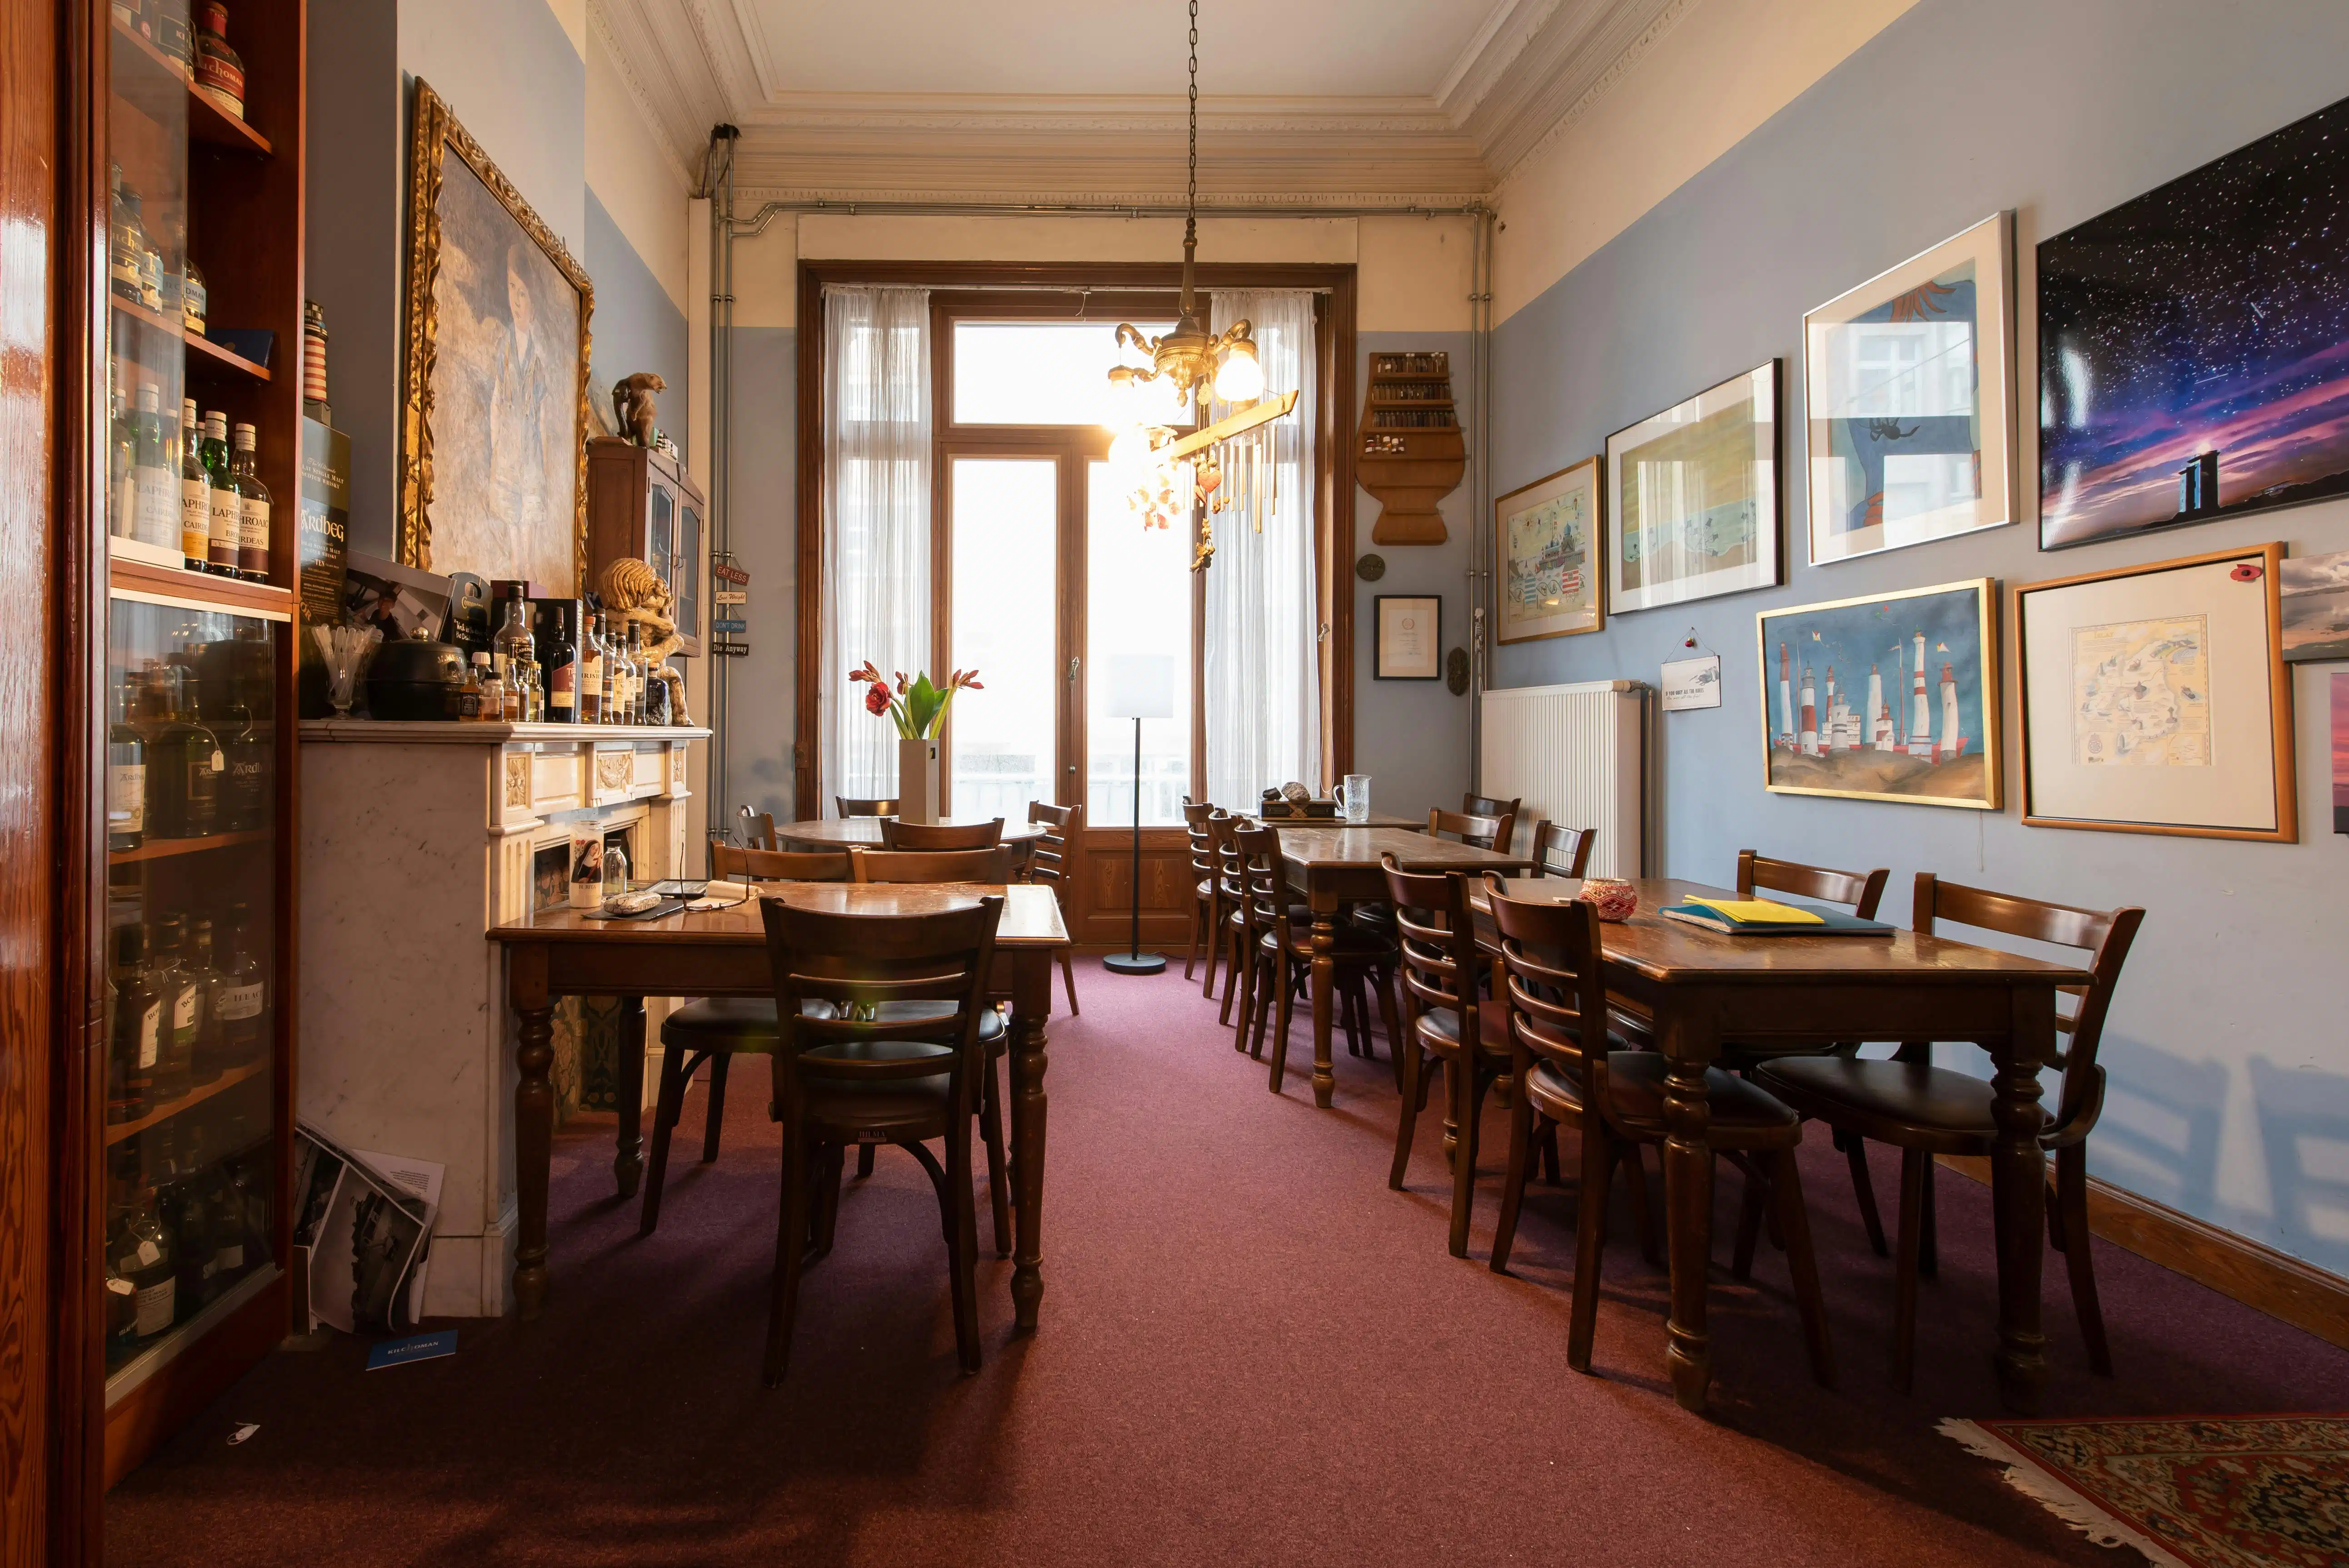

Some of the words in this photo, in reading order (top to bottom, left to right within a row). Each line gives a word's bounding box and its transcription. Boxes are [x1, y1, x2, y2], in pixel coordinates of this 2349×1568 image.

[313, 468, 330, 479] SINGLE
[331, 474, 344, 484] MALT
[322, 478, 340, 489] WHISKY
[314, 544, 329, 552] SINGLE
[717, 566, 730, 576] EAT
[730, 571, 747, 582] LESS
[725, 644, 747, 654] Anyway
